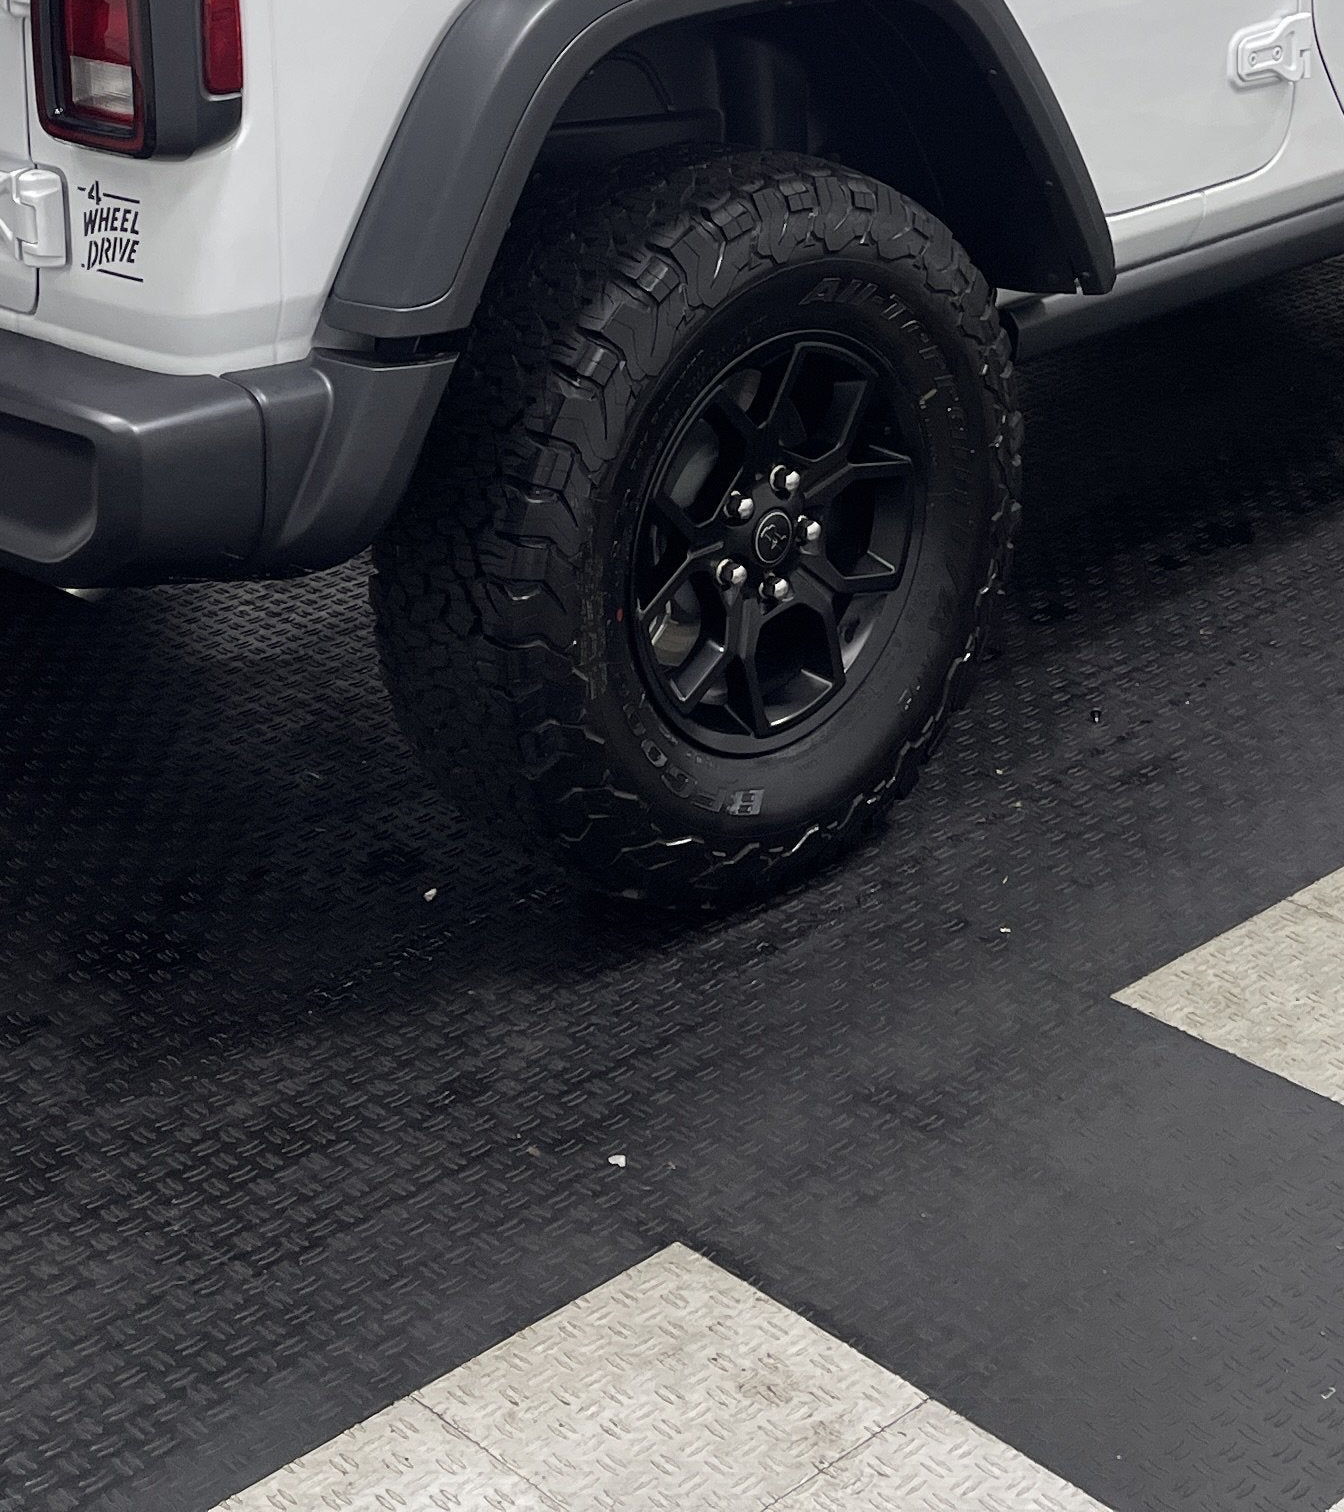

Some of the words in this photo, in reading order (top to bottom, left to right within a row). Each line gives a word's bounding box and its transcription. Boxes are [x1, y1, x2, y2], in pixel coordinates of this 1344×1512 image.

[87, 180, 101, 205] 4
[83, 207, 139, 236] WHEEL
[86, 237, 140, 270] DRIVE
